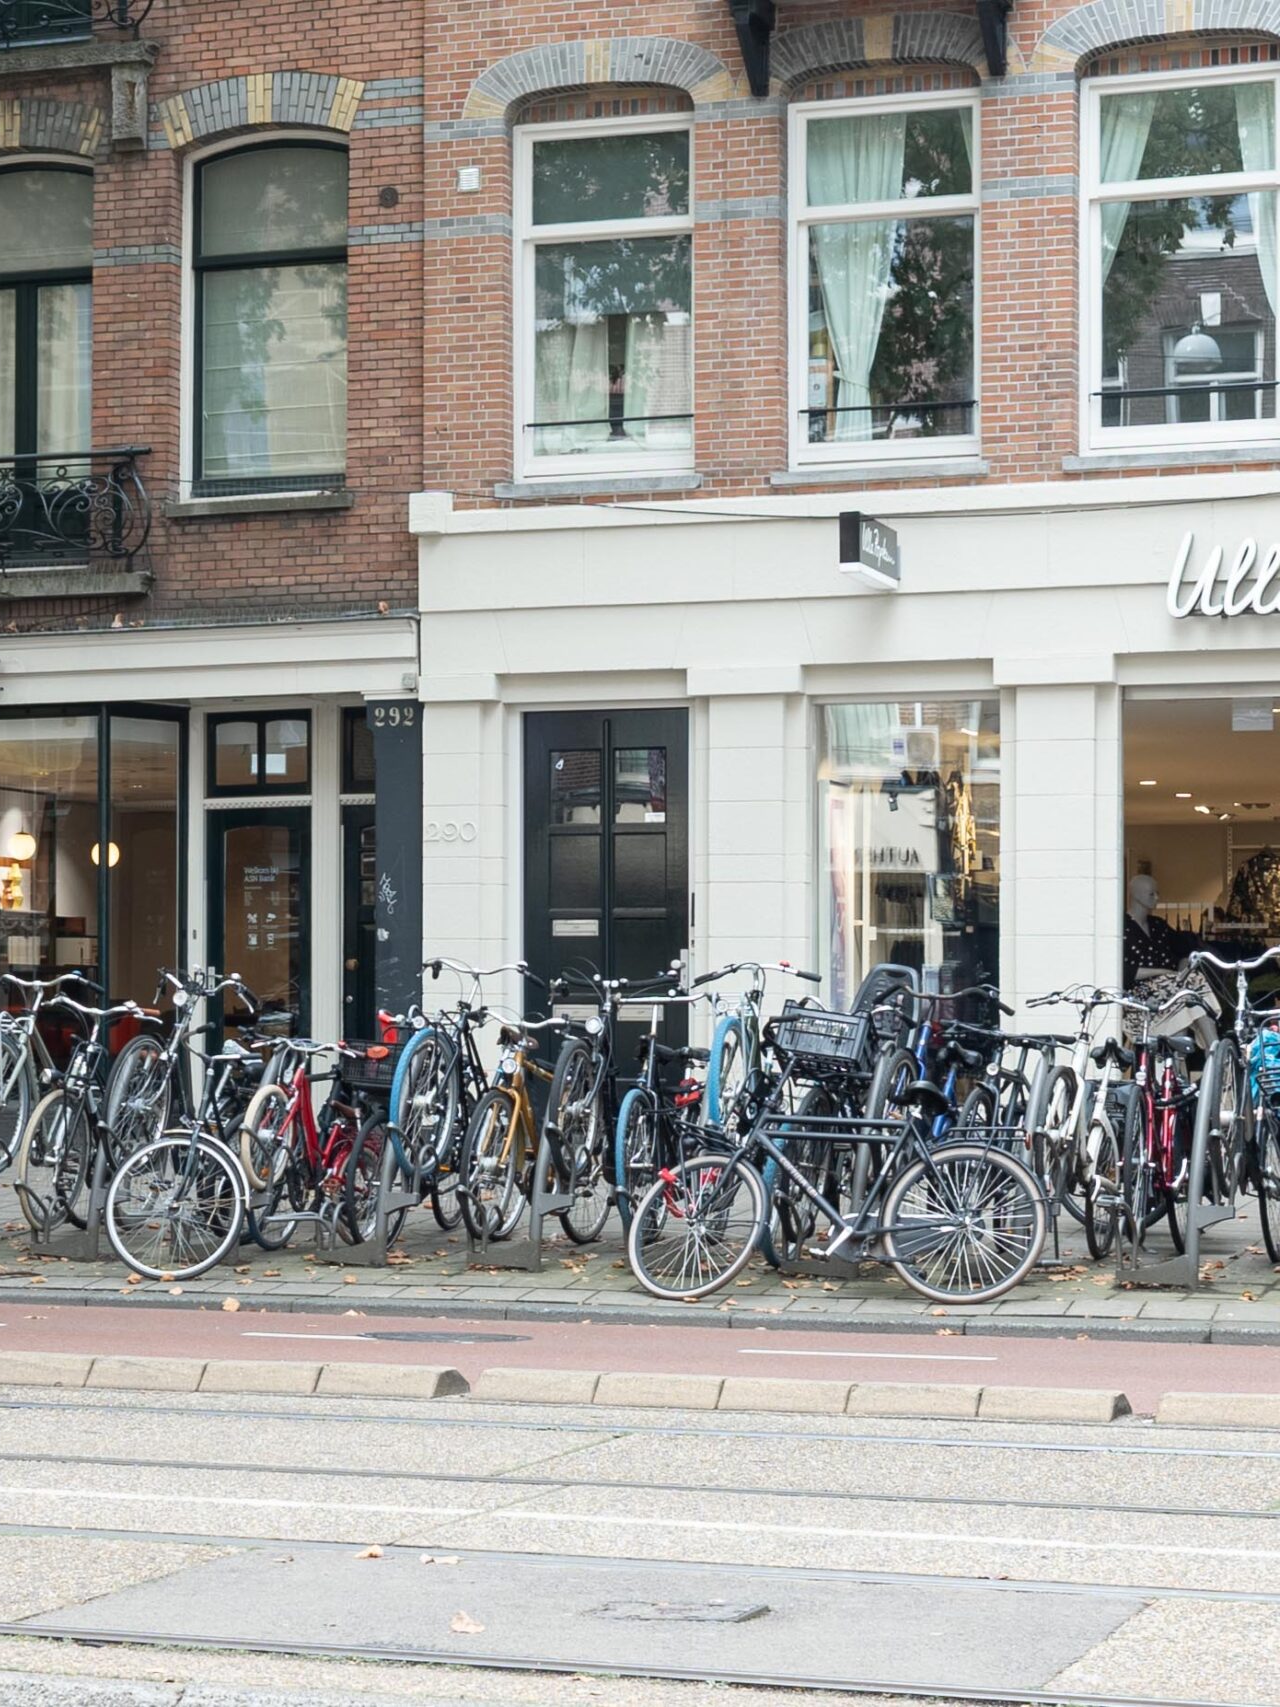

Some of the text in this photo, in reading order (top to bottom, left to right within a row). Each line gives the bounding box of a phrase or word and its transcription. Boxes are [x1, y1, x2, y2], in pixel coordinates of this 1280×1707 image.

[1166, 530, 1280, 618] Ull
[374, 706, 415, 727] 292
[423, 821, 478, 843] 290
